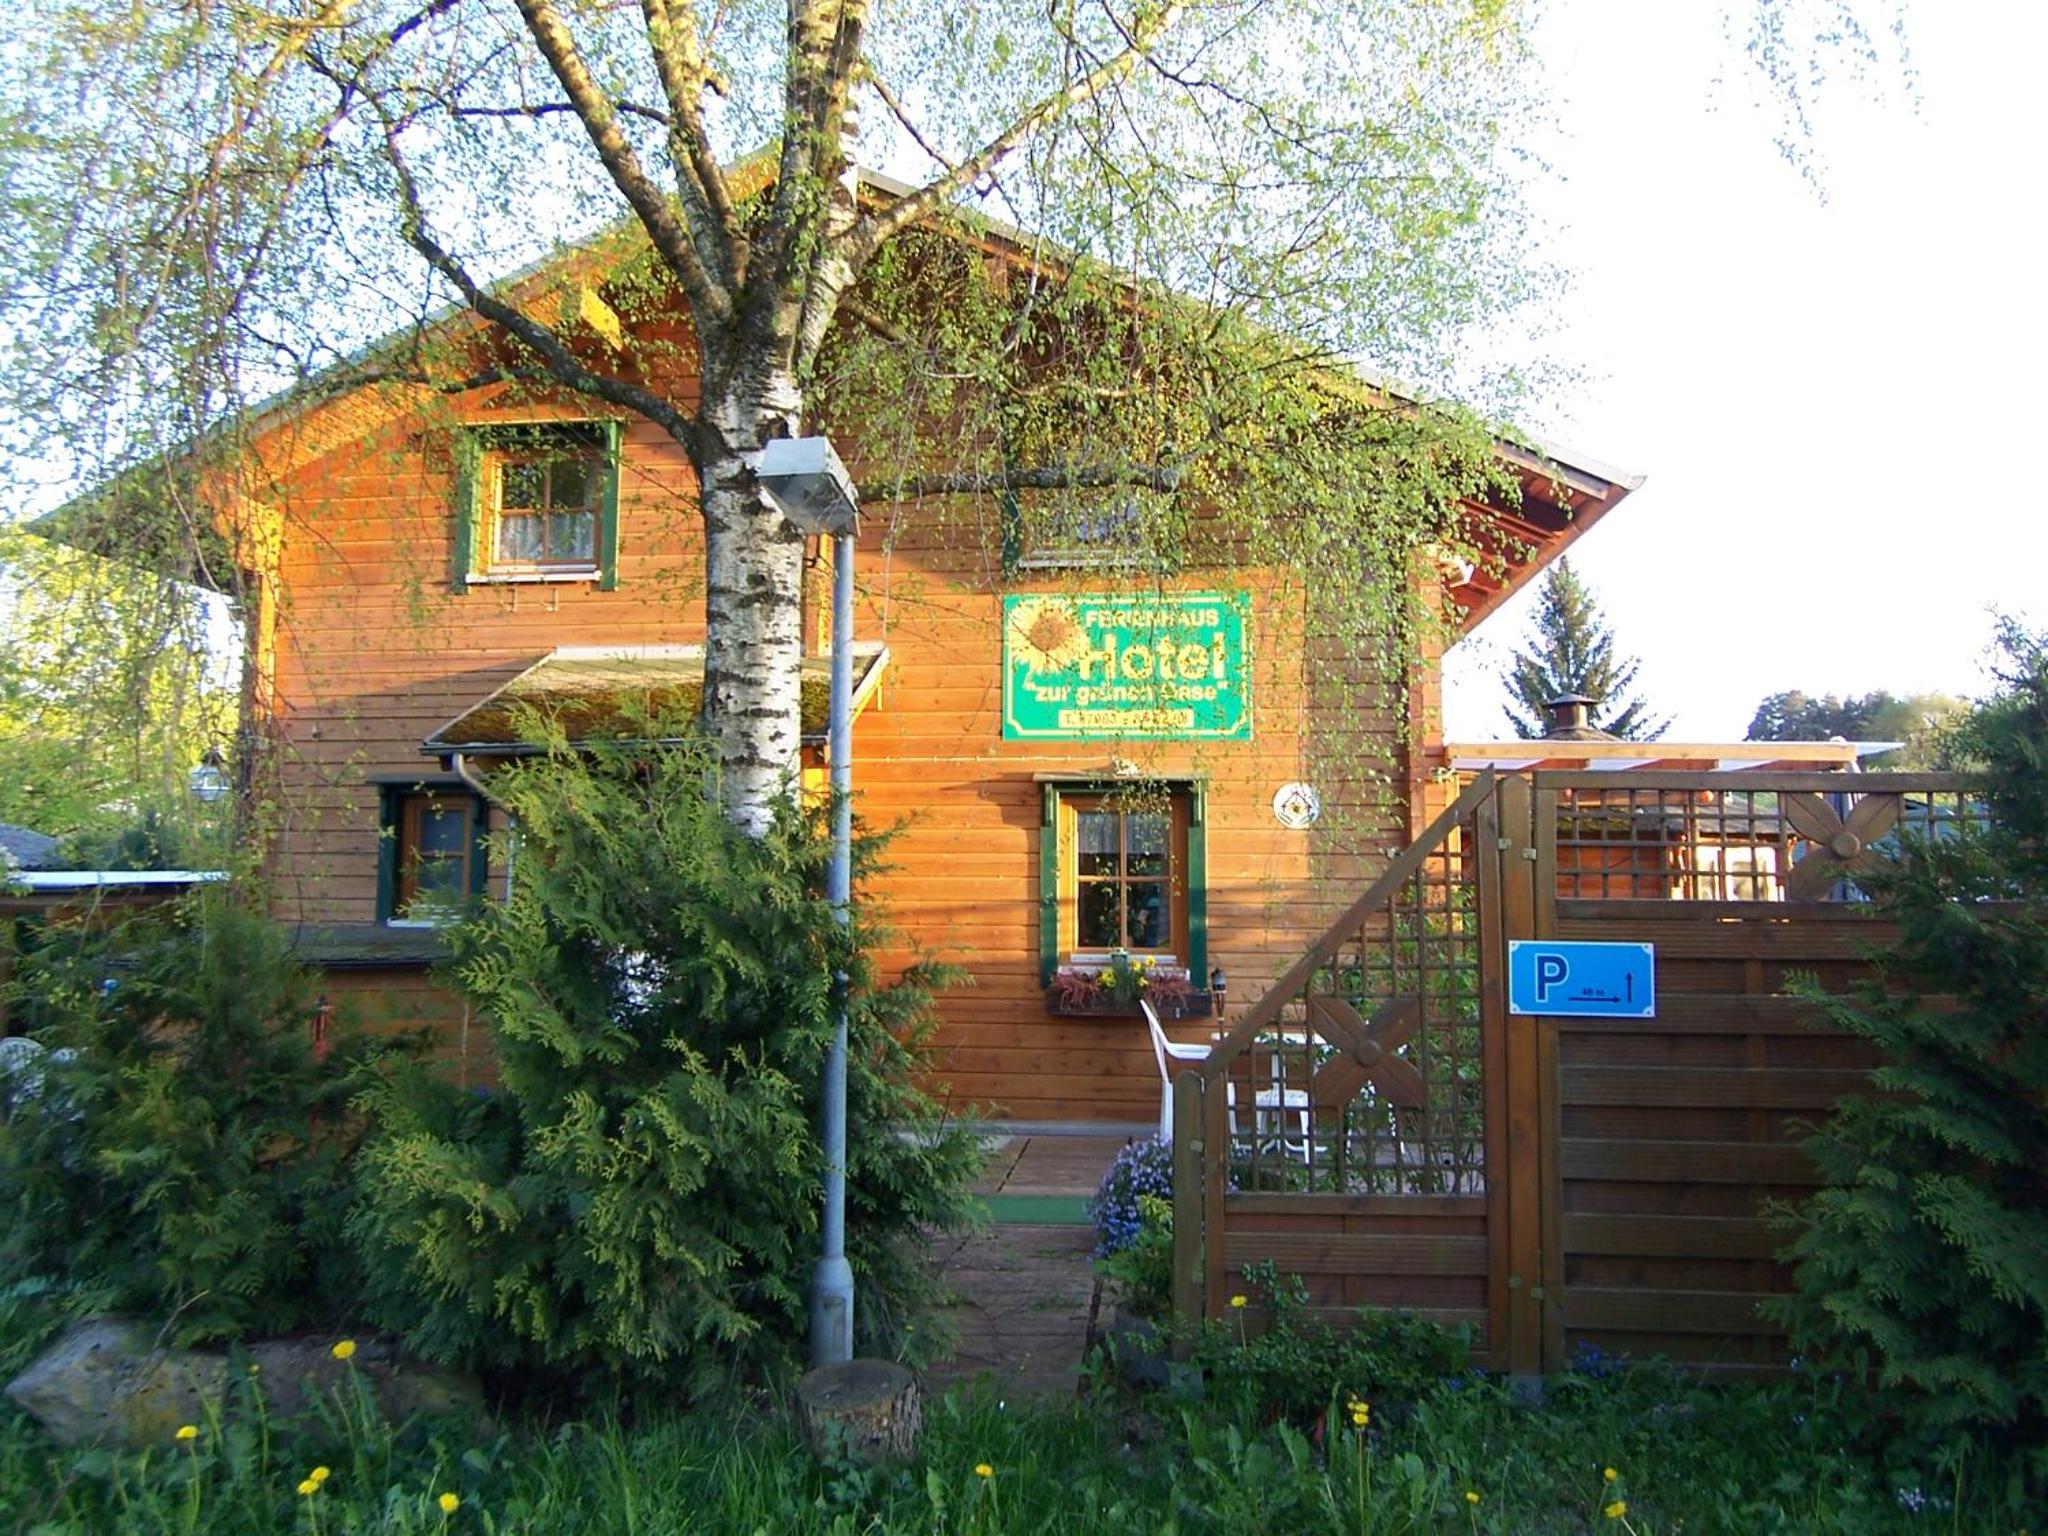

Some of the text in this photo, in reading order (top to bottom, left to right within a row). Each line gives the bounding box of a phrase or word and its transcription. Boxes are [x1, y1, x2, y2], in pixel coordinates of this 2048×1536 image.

[1086, 608, 1219, 628] FERIENHAUS
[1079, 632, 1225, 680] Hotel
[1535, 953, 1570, 1003] P
